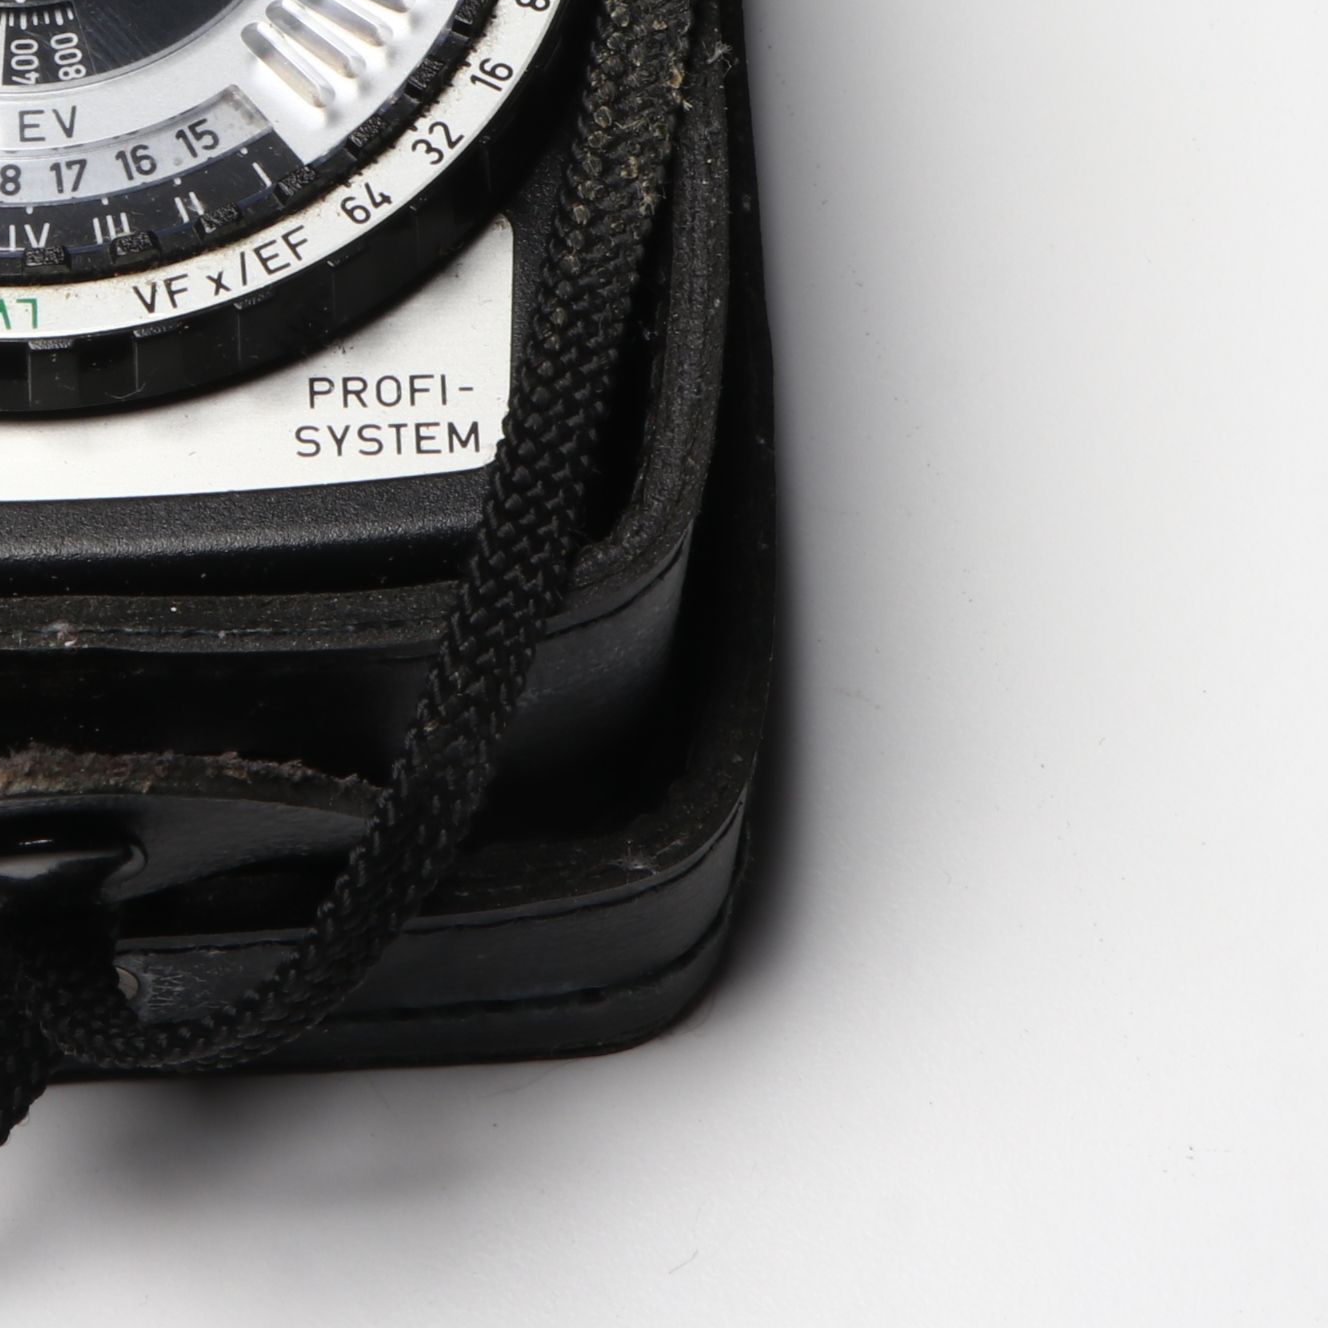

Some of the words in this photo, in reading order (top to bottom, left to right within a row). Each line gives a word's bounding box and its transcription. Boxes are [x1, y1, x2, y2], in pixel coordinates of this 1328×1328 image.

[10, 38, 40, 85] 400
[50, 32, 87, 81] 800
[470, 58, 514, 92] 16
[18, 105, 77, 142] EV
[411, 121, 465, 165] 32
[49, 159, 87, 193] 17
[114, 143, 157, 181] 16
[175, 118, 220, 158] 15
[340, 182, 393, 225] 64
[9, 222, 50, 252] IV
[308, 374, 475, 409] PROFI-
[295, 421, 480, 458] SYSTEM
